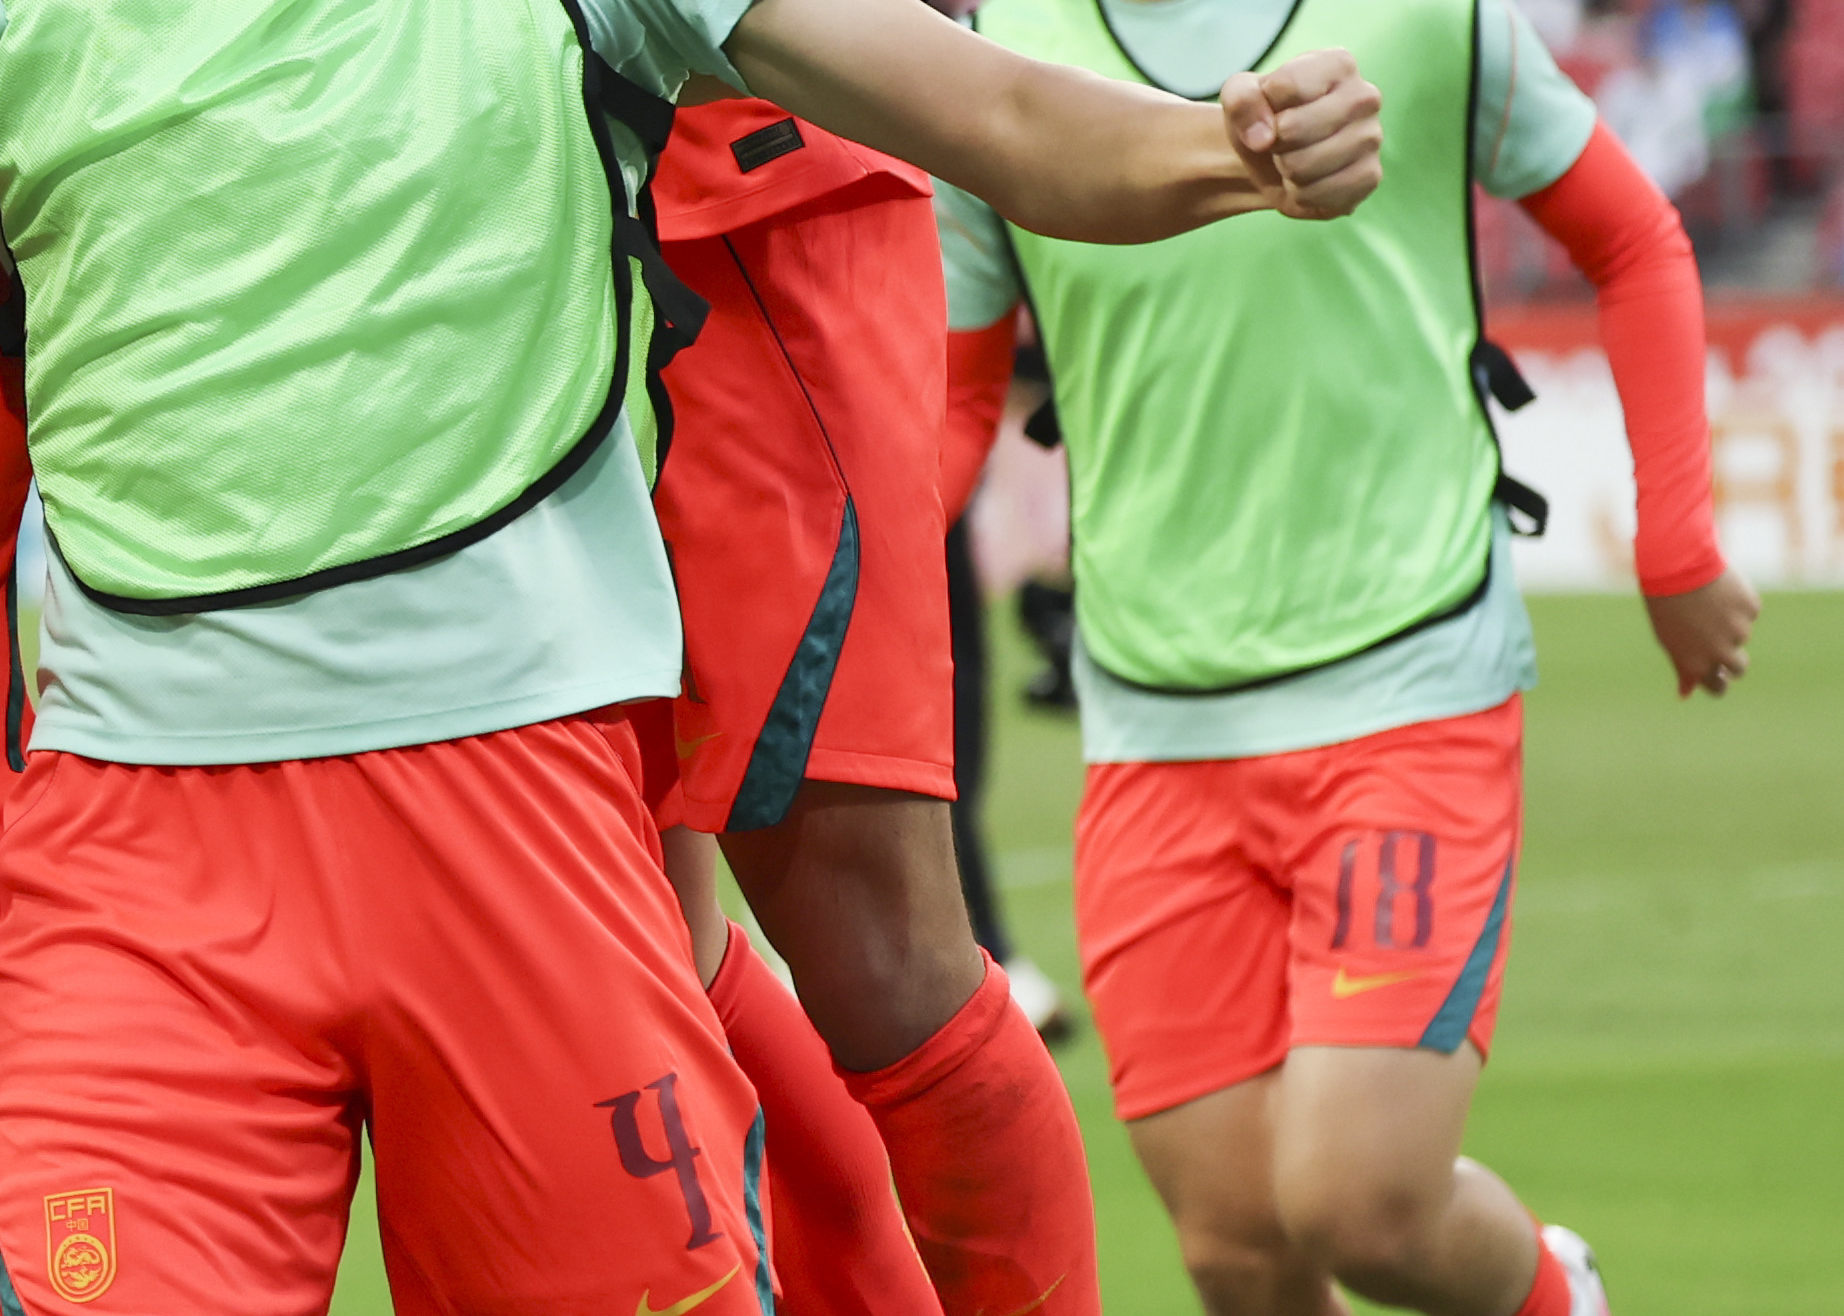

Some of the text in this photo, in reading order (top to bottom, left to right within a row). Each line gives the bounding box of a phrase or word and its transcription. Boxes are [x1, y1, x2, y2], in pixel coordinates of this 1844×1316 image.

[1328, 828, 1436, 952] 18
[51, 1195, 106, 1221] CFA
[593, 1073, 724, 1250] 4
